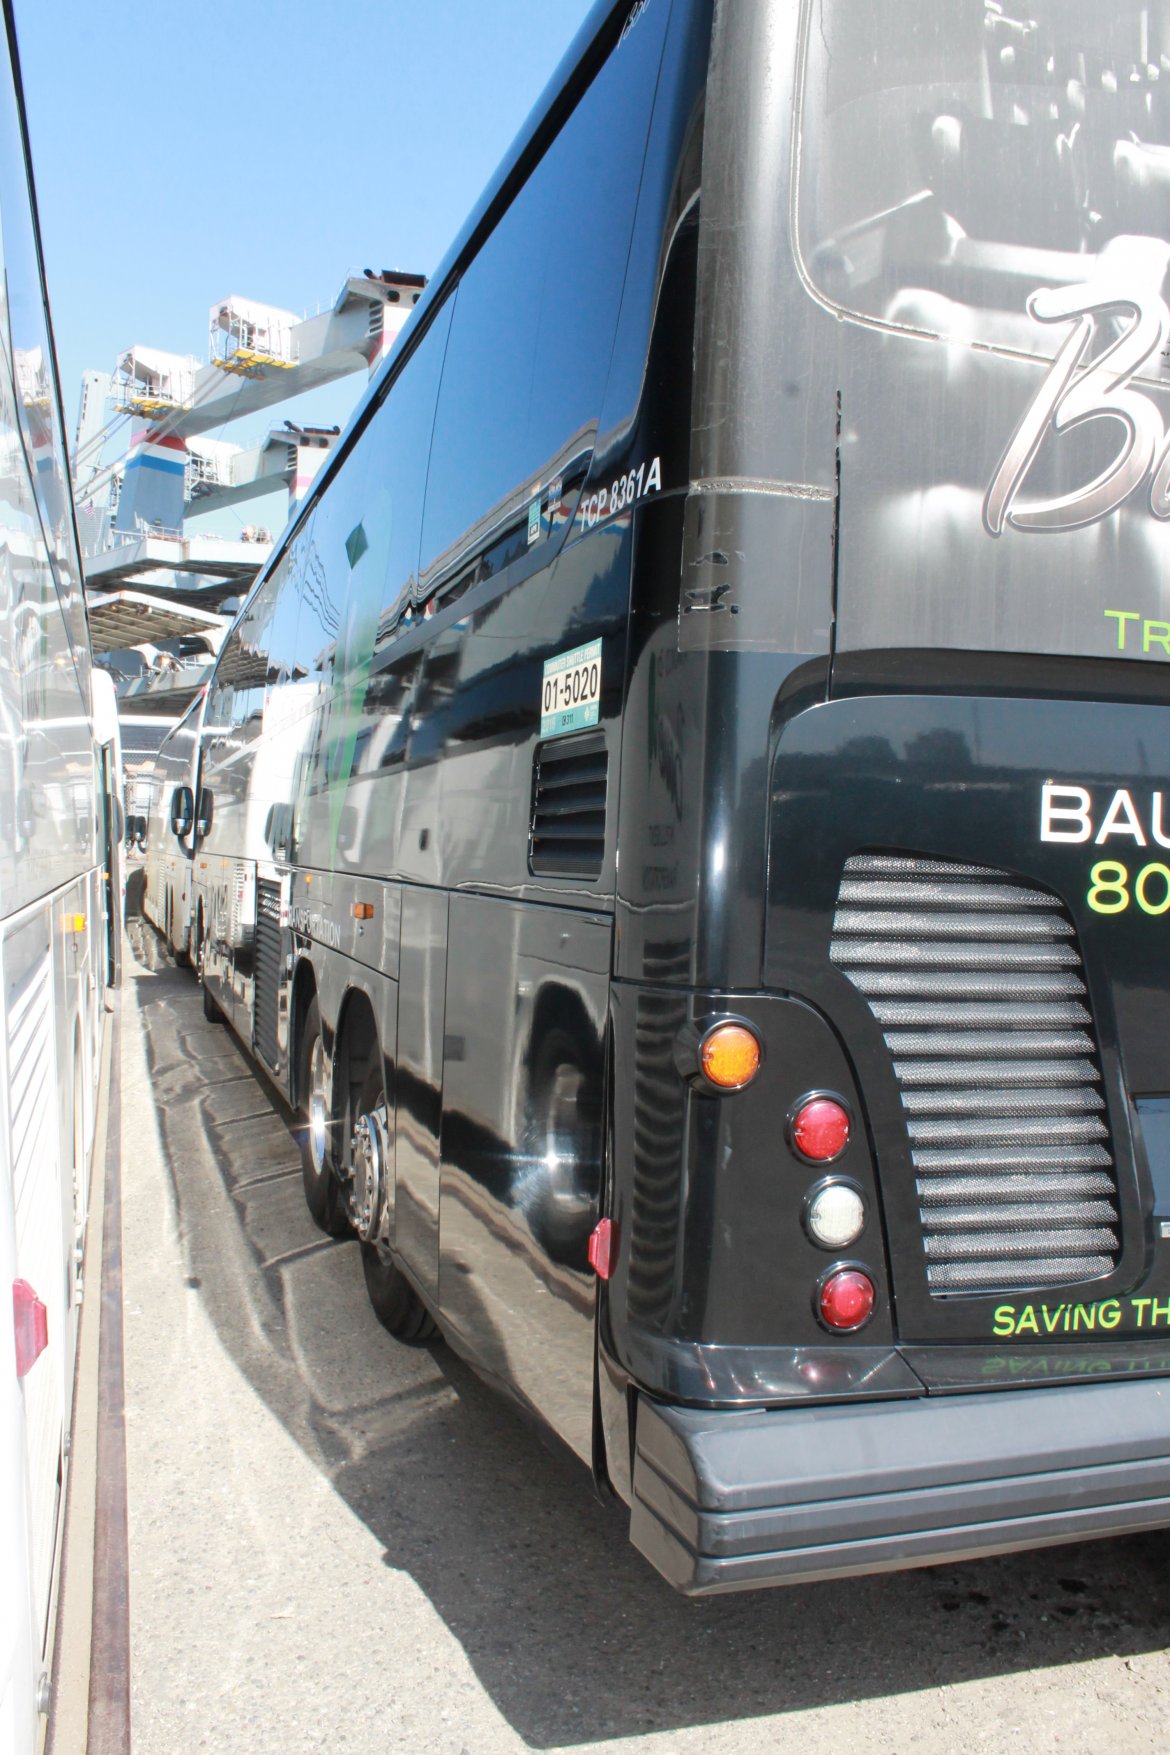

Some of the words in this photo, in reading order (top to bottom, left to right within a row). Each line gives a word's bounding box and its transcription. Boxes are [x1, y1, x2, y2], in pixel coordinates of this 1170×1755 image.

[581, 488, 607, 532] TCP
[610, 456, 661, 514] 8361A
[1103, 609, 1170, 655] TR
[544, 663, 598, 712] 01-5020
[993, 1299, 1122, 1336] SAVING
